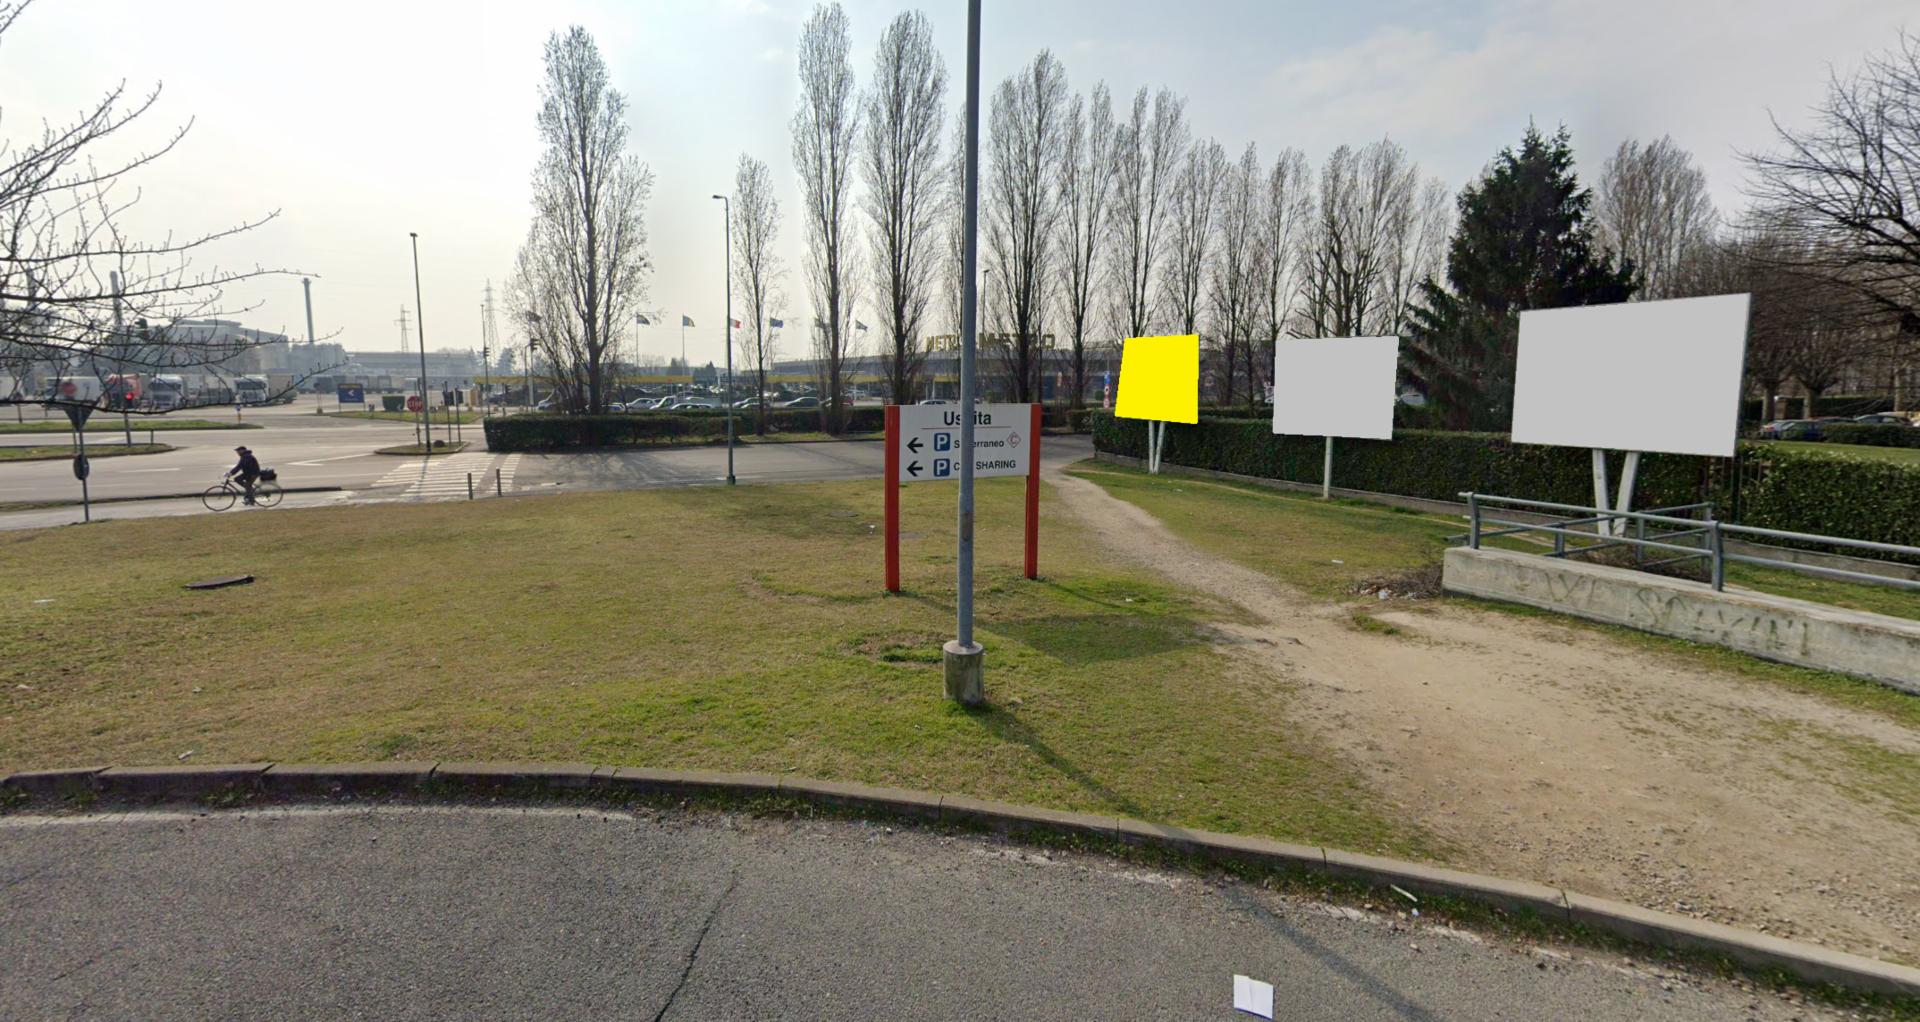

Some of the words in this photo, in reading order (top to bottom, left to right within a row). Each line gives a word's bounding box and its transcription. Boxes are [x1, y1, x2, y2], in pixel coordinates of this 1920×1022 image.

[944, 411, 991, 425] Usita
[936, 434, 948, 450] P
[953, 440, 1004, 449] Serraneo
[936, 459, 948, 475] P
[976, 460, 1016, 470] SHARING
